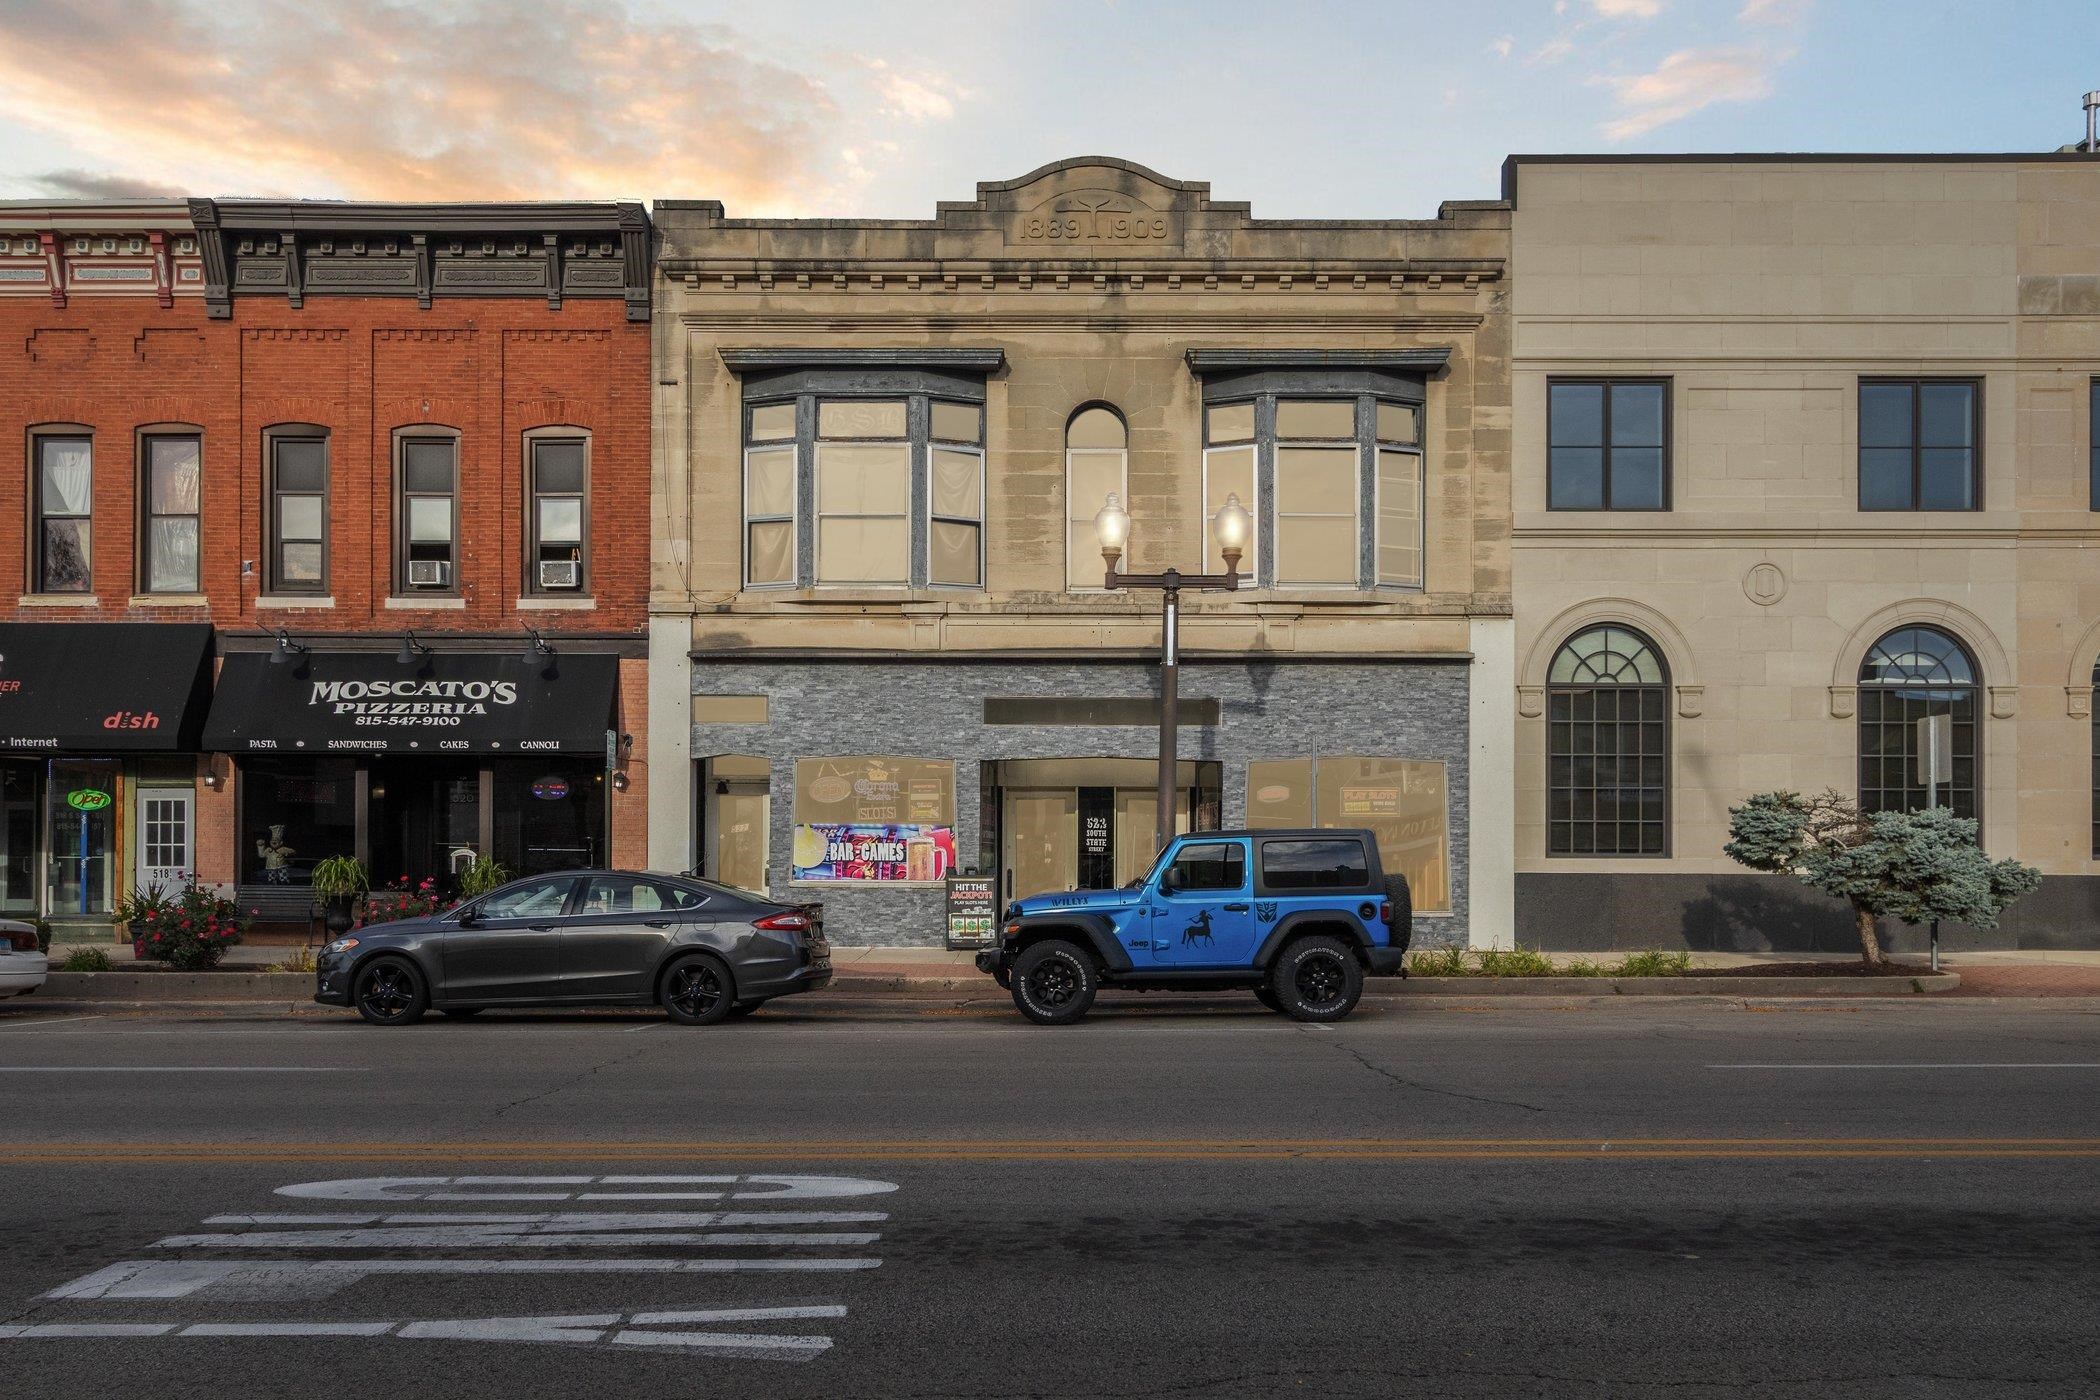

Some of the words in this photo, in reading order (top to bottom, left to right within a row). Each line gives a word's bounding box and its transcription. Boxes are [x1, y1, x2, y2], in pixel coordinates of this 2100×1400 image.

[1020, 218, 1081, 239] 1889
[1107, 218, 1168, 239] 1909
[309, 680, 518, 706] MOSCATO'S
[333, 701, 487, 715] PIZZERIA
[103, 711, 160, 730] dish
[354, 716, 461, 727] 815-547-9100
[10, 736, 58, 747] Internet
[249, 739, 278, 749] PASTA
[328, 739, 388, 750] SANDWICHES
[440, 740, 470, 750] CAKES
[520, 740, 560, 750] CANNOLI
[860, 806, 893, 819] SLOTS
[1086, 817, 1107, 829] 523
[1086, 829, 1107, 837] SOUTH
[1086, 838, 1107, 847] STATE
[829, 843, 853, 861] BAR
[861, 843, 904, 861] GAMES
[153, 869, 169, 879] 518
[955, 883, 970, 891] HIT
[970, 883, 987, 891] THE
[950, 891, 993, 900] JACKPOT!
[1051, 896, 1089, 907] WILLYS
[1128, 939, 1149, 948] Jeep
